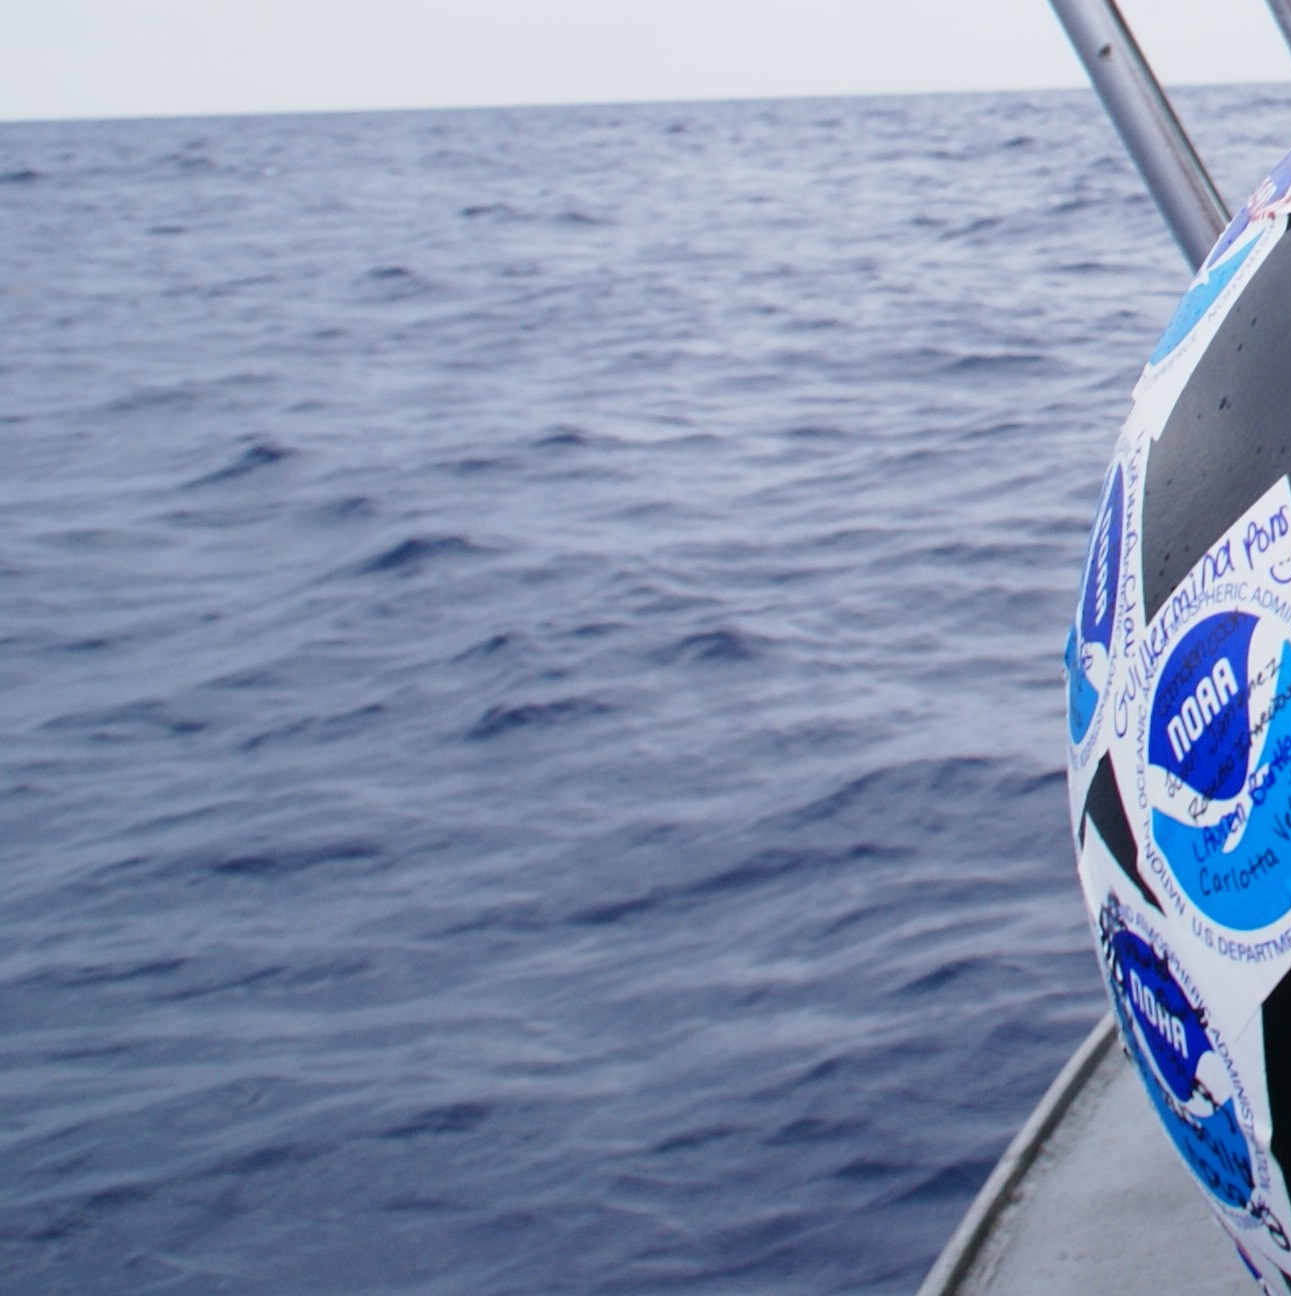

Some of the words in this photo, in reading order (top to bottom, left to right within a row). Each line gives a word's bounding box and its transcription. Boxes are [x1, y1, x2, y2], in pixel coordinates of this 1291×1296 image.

[1166, 656, 1240, 762] NOAA
[1141, 818, 1187, 916] NATIONAL
[1199, 849, 1281, 898] Carlotta
[1191, 918, 1215, 949] U.S.
[1128, 967, 1189, 1060] NOAA
